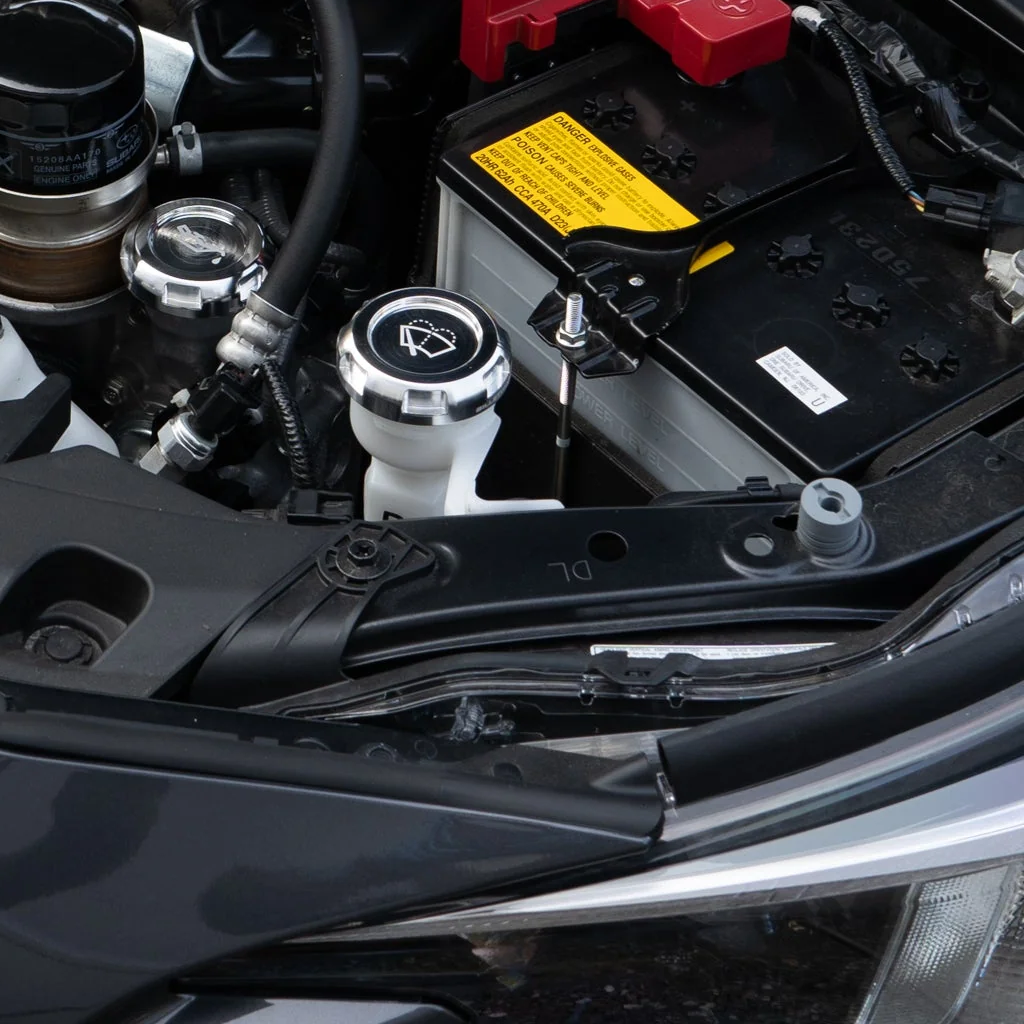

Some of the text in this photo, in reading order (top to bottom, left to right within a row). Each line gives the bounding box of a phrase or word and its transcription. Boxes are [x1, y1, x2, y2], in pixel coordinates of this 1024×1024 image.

[34, 159, 97, 174] GENUINE PARTS
[509, 136, 606, 213] POISON CAUSES SEVERE BURNS
[522, 130, 611, 200] KEEP VENT CAPS TIGHT AND LEVEL
[552, 115, 636, 181] DANGER EXPLOSIVE GASES
[474, 153, 499, 171] 20HR
[493, 168, 517, 185] 62Ah
[512, 184, 535, 200] CCA
[528, 198, 553, 215] 470A
[487, 148, 574, 217] KEEP OUT OF REACH OF CHILDREN
[575, 385, 614, 425] OWER
[810, 397, 825, 407] U
